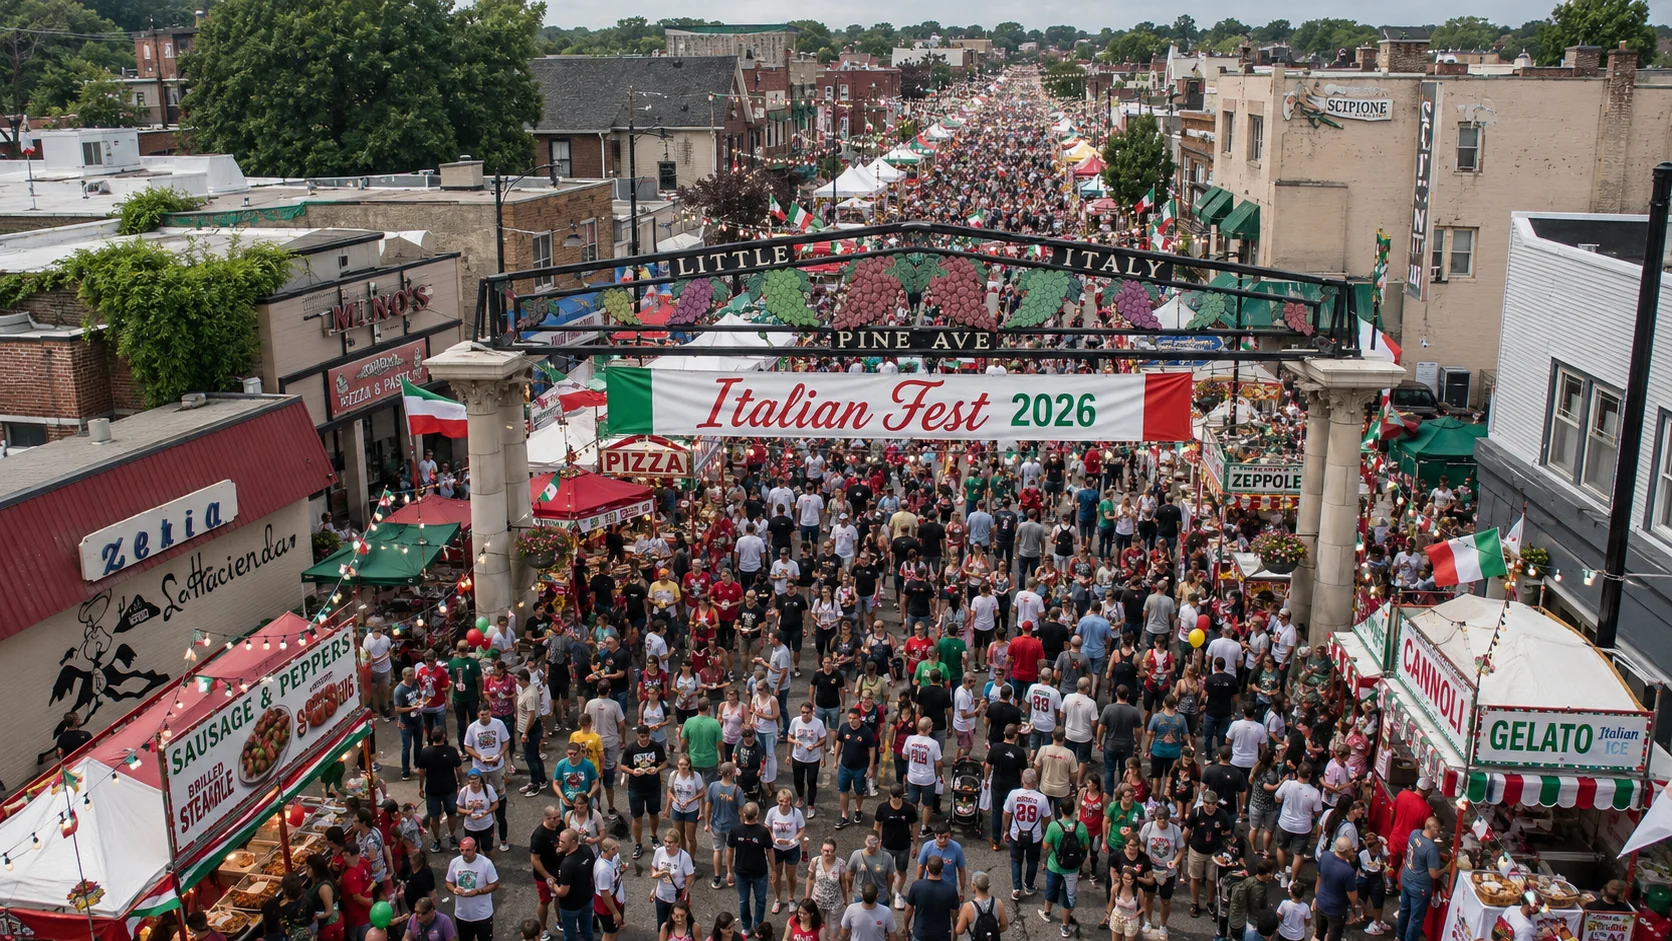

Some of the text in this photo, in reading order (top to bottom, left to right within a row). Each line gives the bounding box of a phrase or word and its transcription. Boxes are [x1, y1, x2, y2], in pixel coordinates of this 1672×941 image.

[1327, 99, 1388, 114] SCIPIONE
[677, 244, 1167, 279] LITTLE ITALY
[837, 331, 991, 350] PINE AVE
[696, 378, 1097, 432] Italian Fest 2026
[606, 451, 685, 474] PIZZA
[1231, 473, 1302, 489] ZEPPOLE
[1404, 638, 1464, 735] CANNOLI
[172, 697, 254, 775] SAUSAGE
[260, 686, 273, 709] &
[279, 632, 351, 698] PEPPERS
[1489, 719, 1594, 755] GELATO
[1598, 726, 1639, 740] Italian
[1604, 741, 1629, 755] ICE
[188, 761, 224, 799] BRILLED
